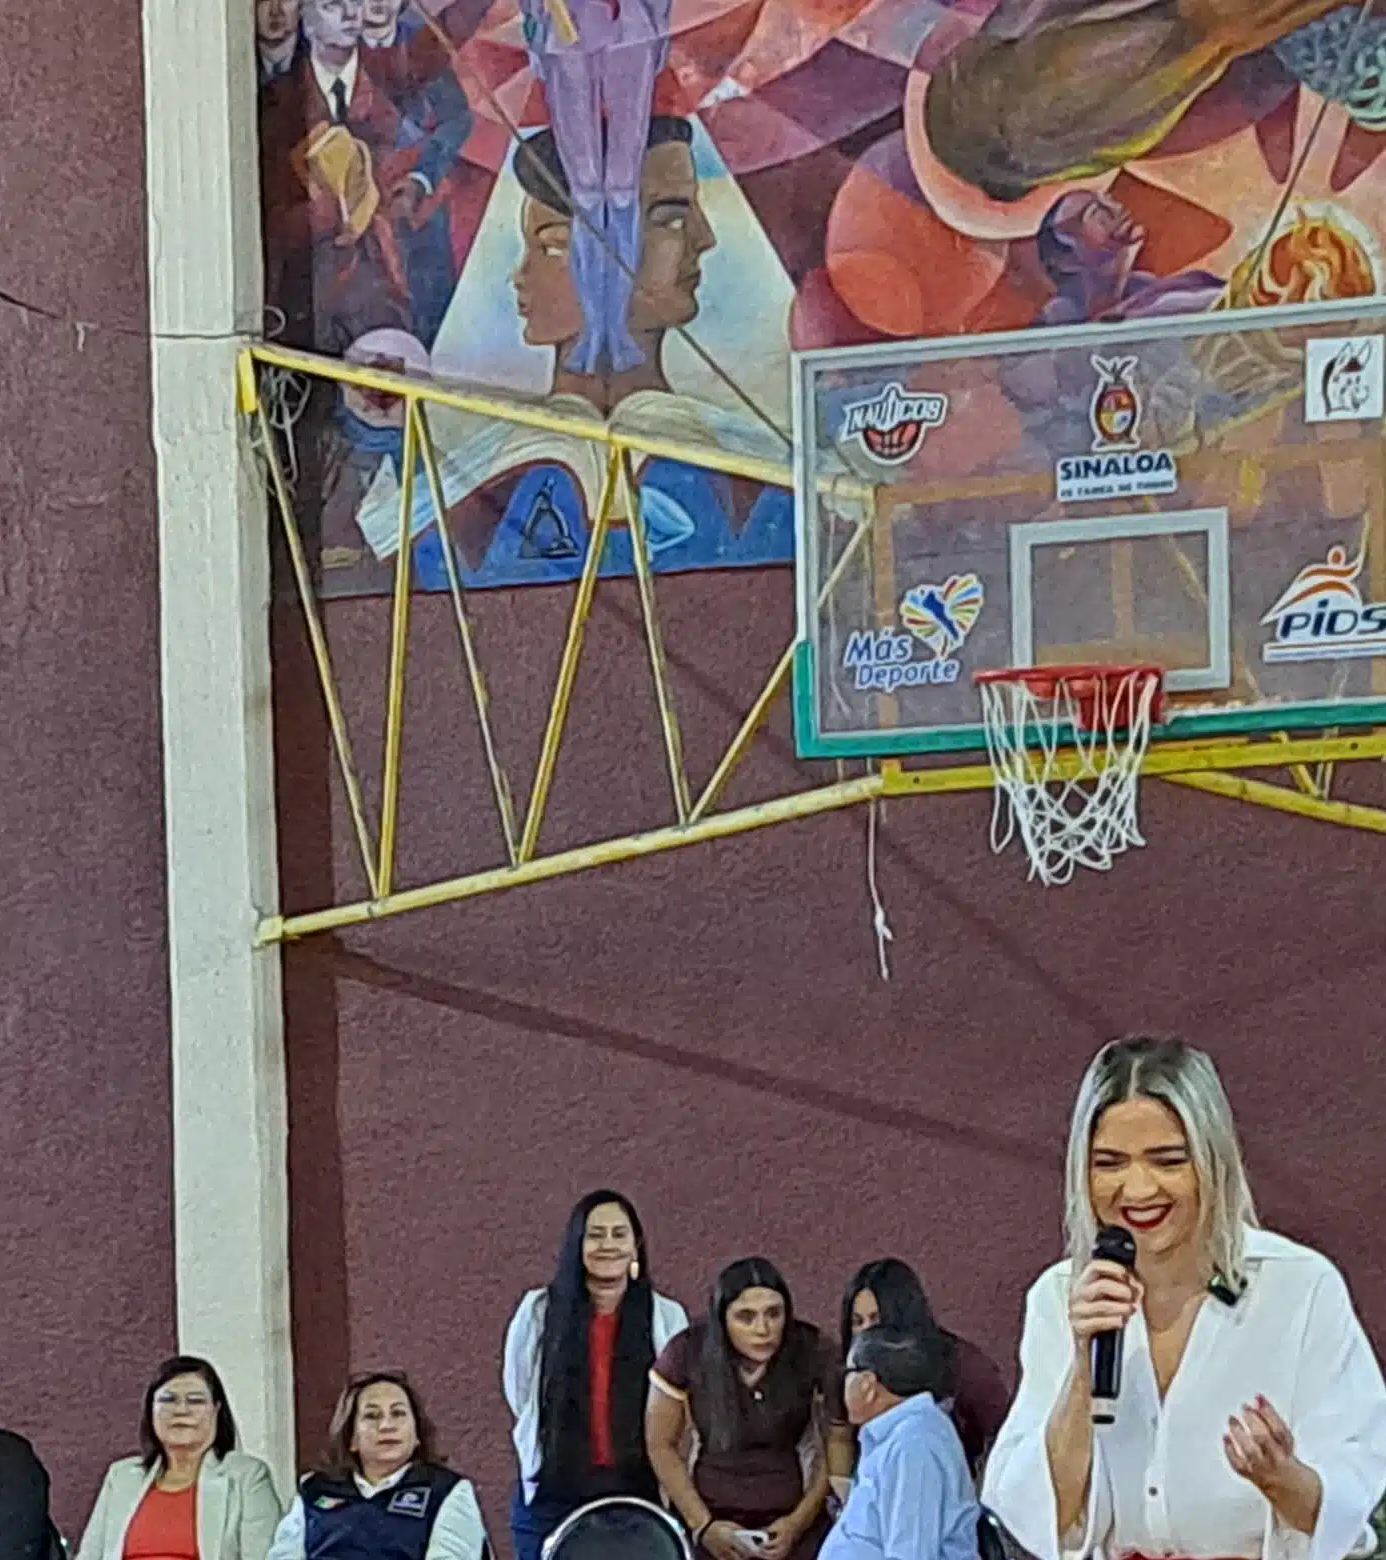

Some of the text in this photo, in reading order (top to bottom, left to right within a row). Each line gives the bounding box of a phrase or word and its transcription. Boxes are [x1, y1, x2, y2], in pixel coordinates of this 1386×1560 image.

[1060, 452, 1173, 481] SINALOA
[847, 628, 910, 662] Más
[858, 660, 956, 688] Deporte
